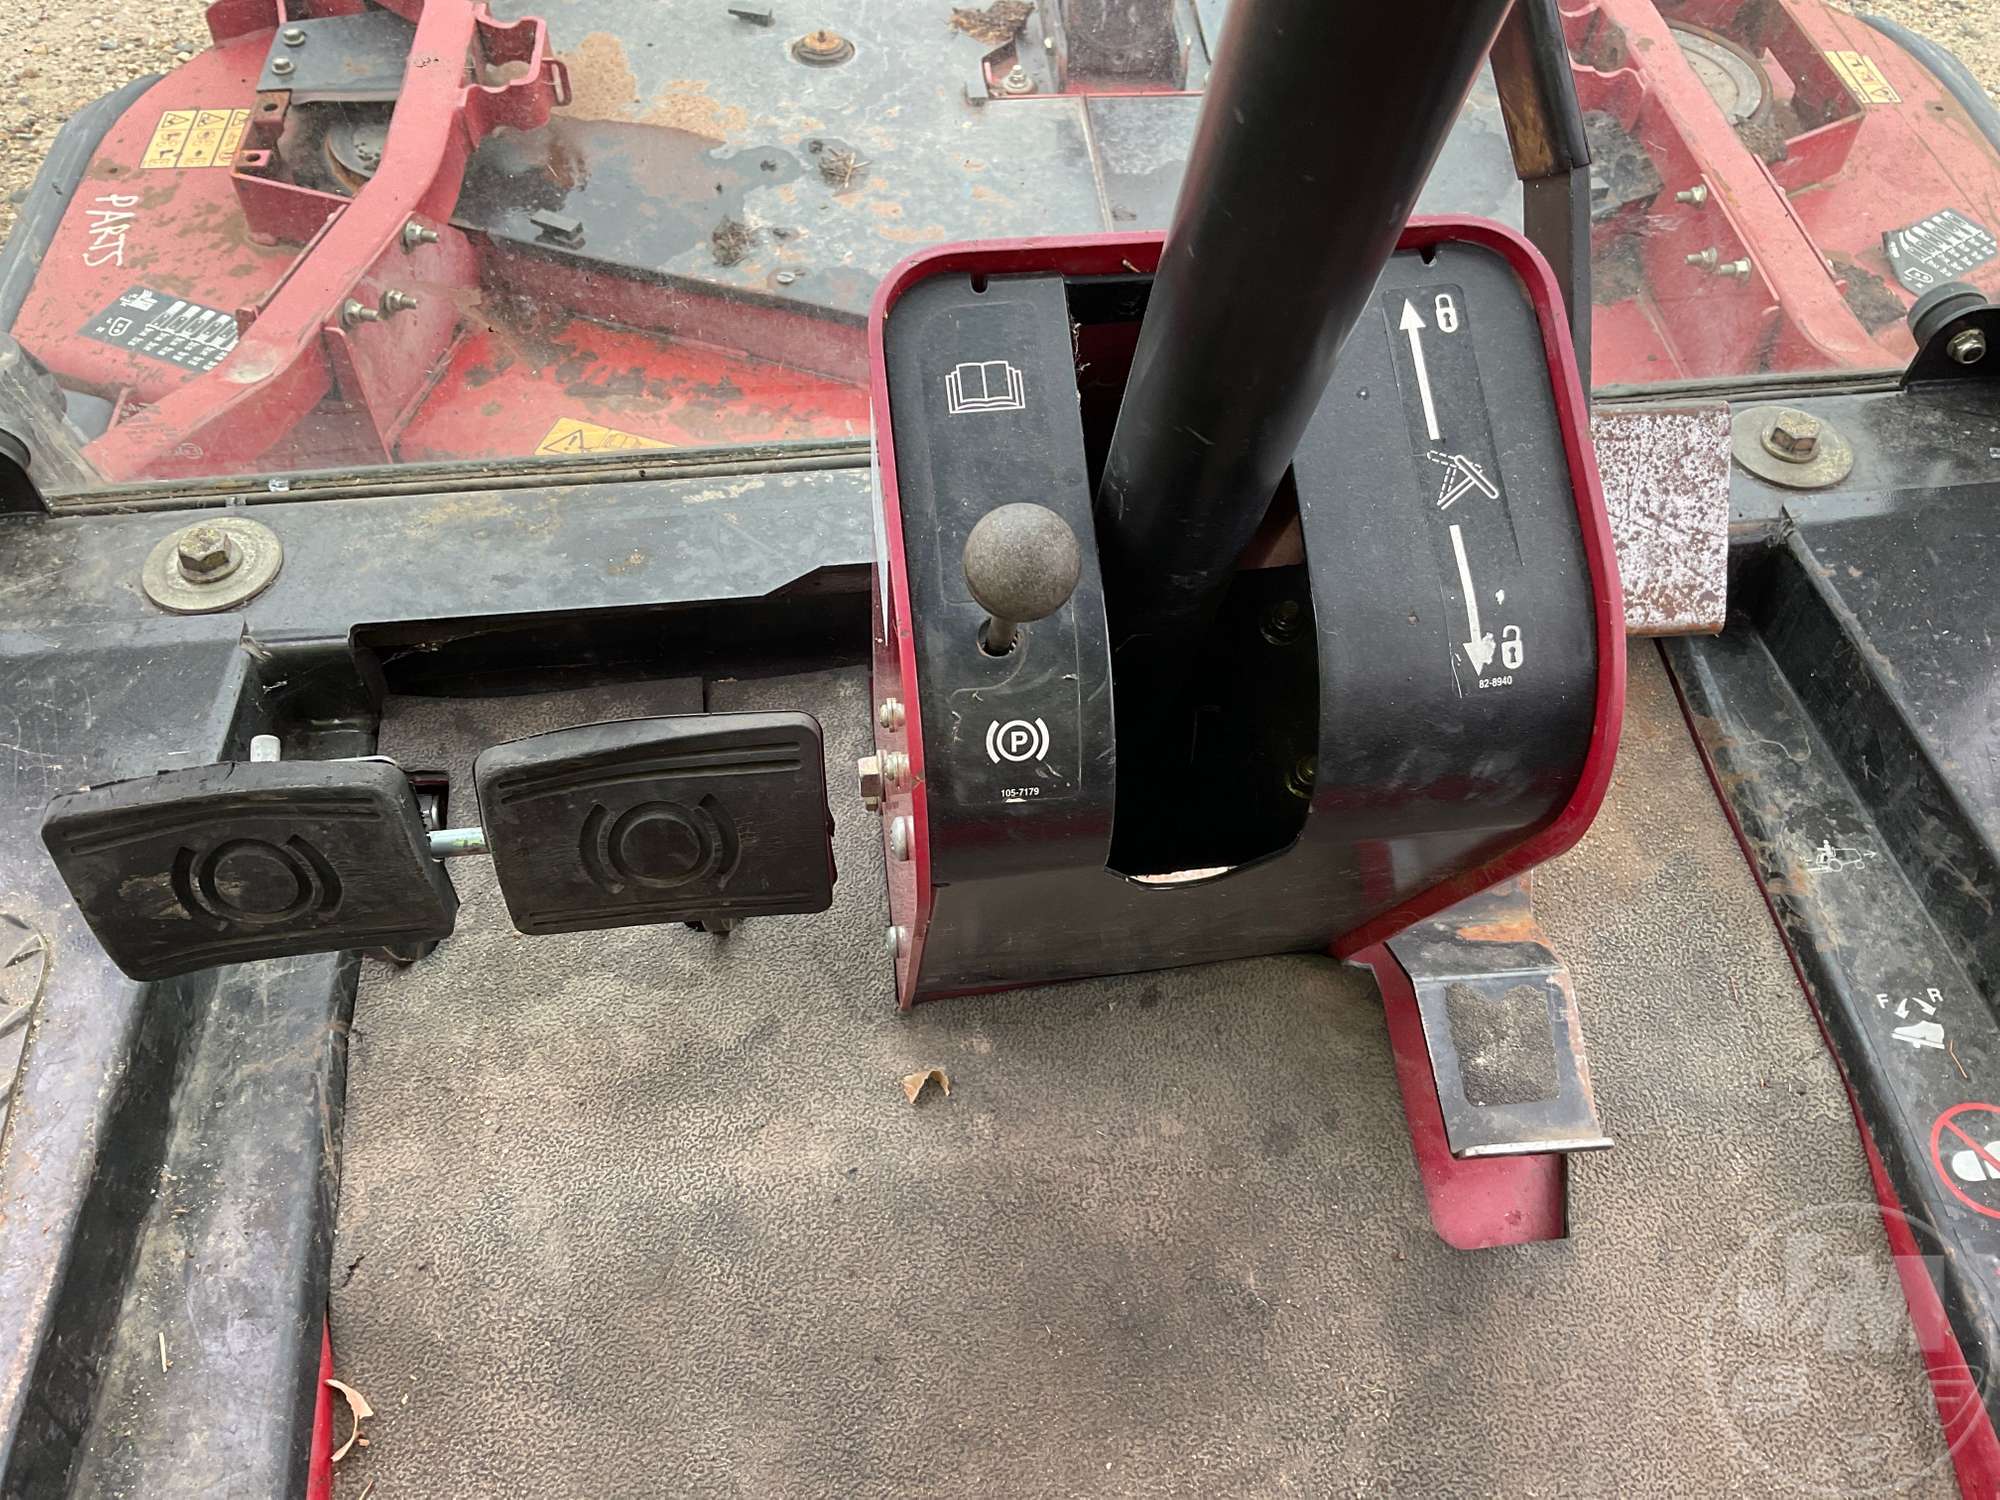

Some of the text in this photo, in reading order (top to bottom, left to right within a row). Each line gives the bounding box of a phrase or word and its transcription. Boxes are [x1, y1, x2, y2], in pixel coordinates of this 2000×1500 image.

[82, 194, 139, 267] PARTS
[1478, 675, 1513, 689] 82-8940
[1010, 730, 1028, 753] P
[1001, 786, 1040, 798] 105-7179
[1876, 993, 1889, 1009] F
[1926, 987, 1944, 1003] R
